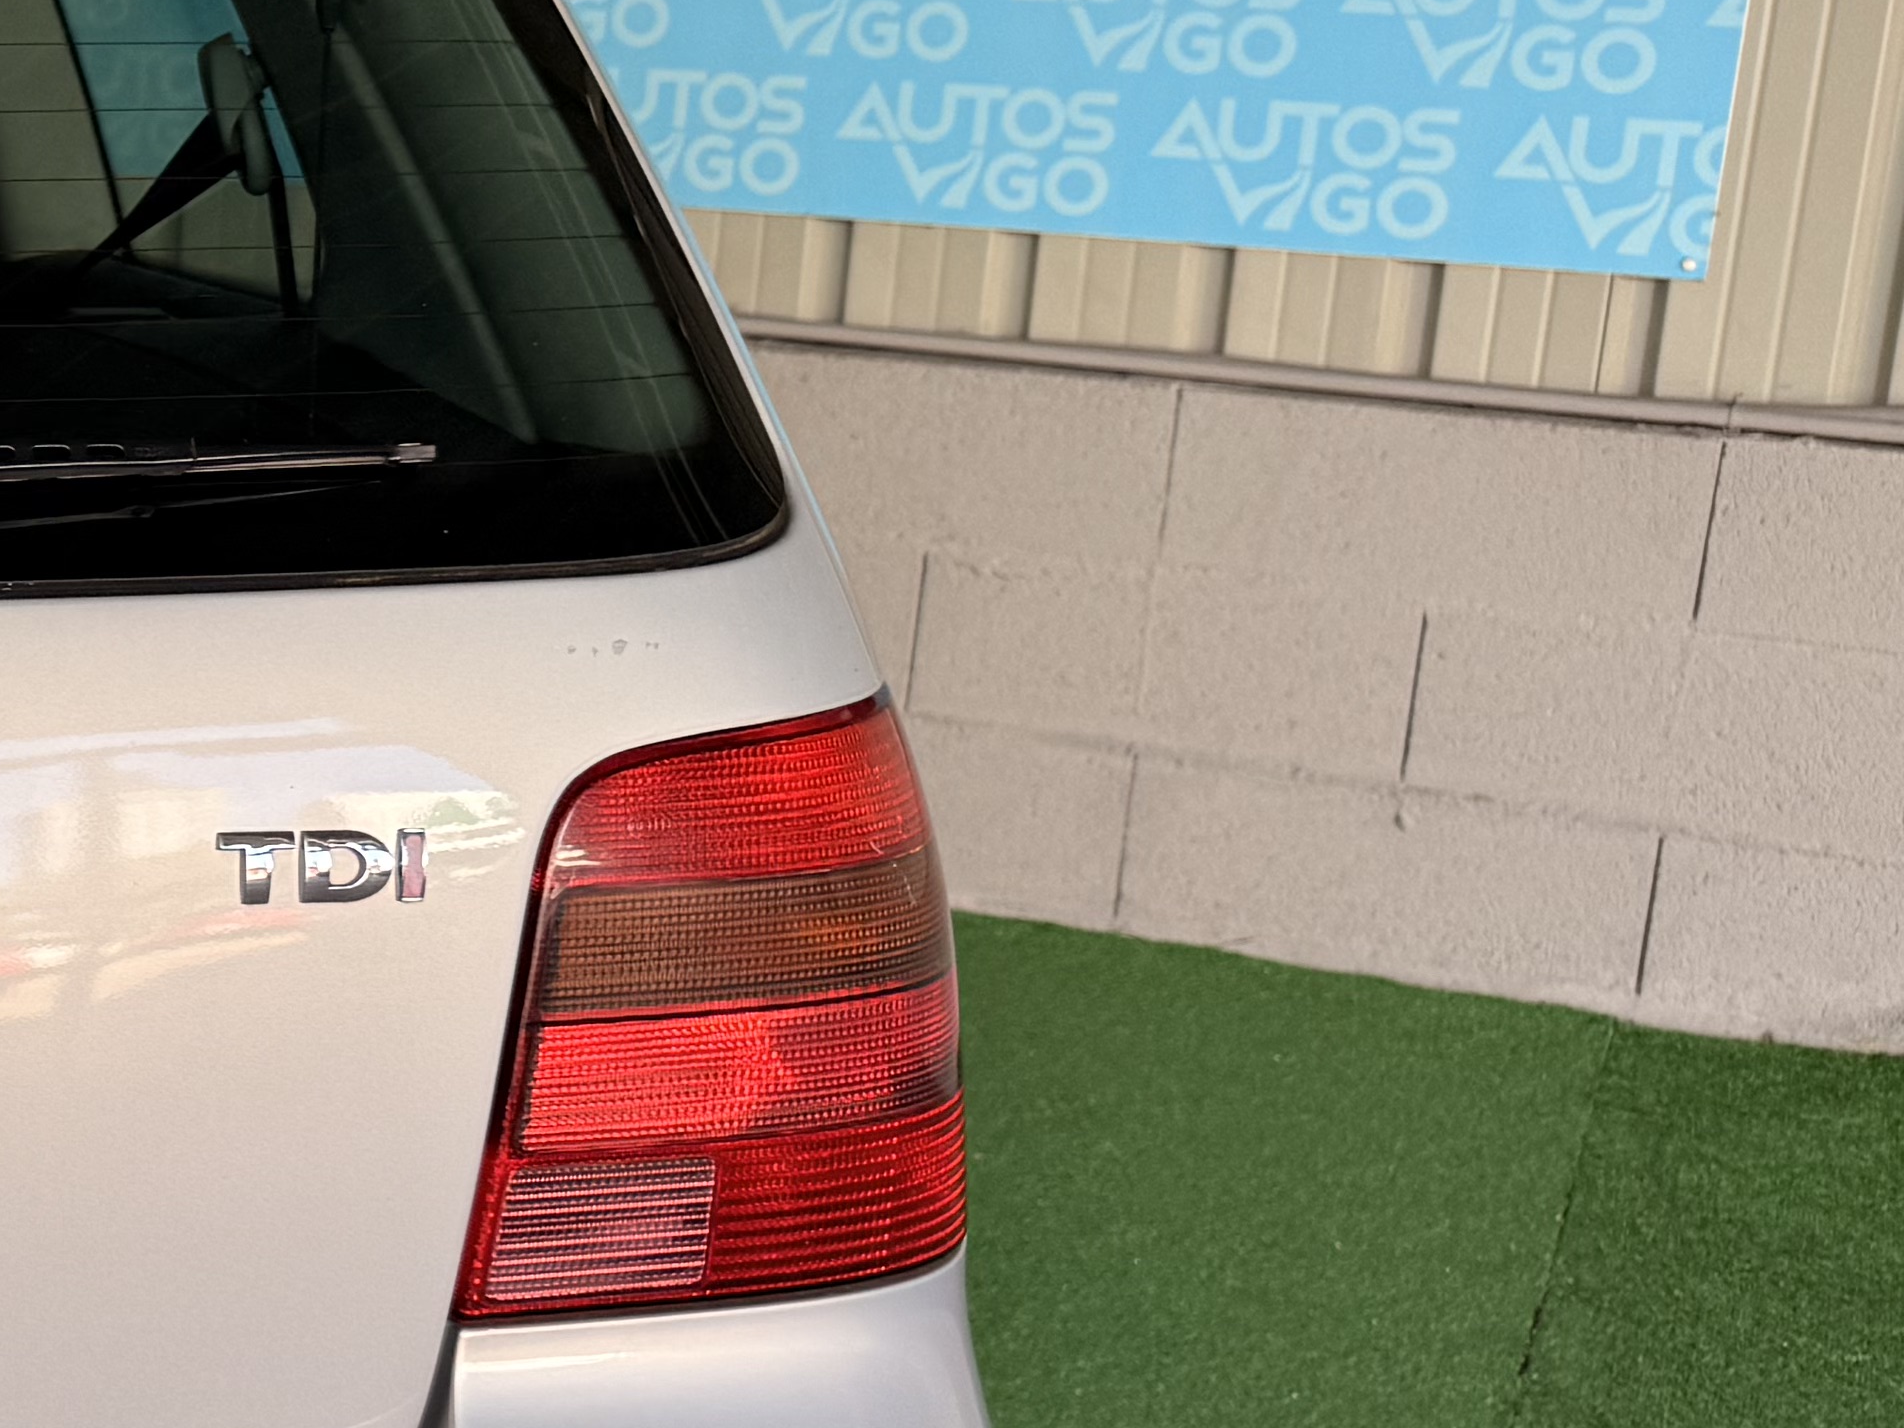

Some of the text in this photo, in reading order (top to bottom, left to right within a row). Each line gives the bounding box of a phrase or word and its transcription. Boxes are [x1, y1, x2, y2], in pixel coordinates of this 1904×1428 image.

[1069, 2, 1300, 78] VIGO
[1407, 15, 1657, 96] VIGO
[833, 77, 1120, 155] AUTOS
[1147, 95, 1463, 175] AUTOS
[894, 142, 1109, 217] VIGO
[1213, 161, 1450, 243] VIGO
[215, 827, 429, 905] TDI
